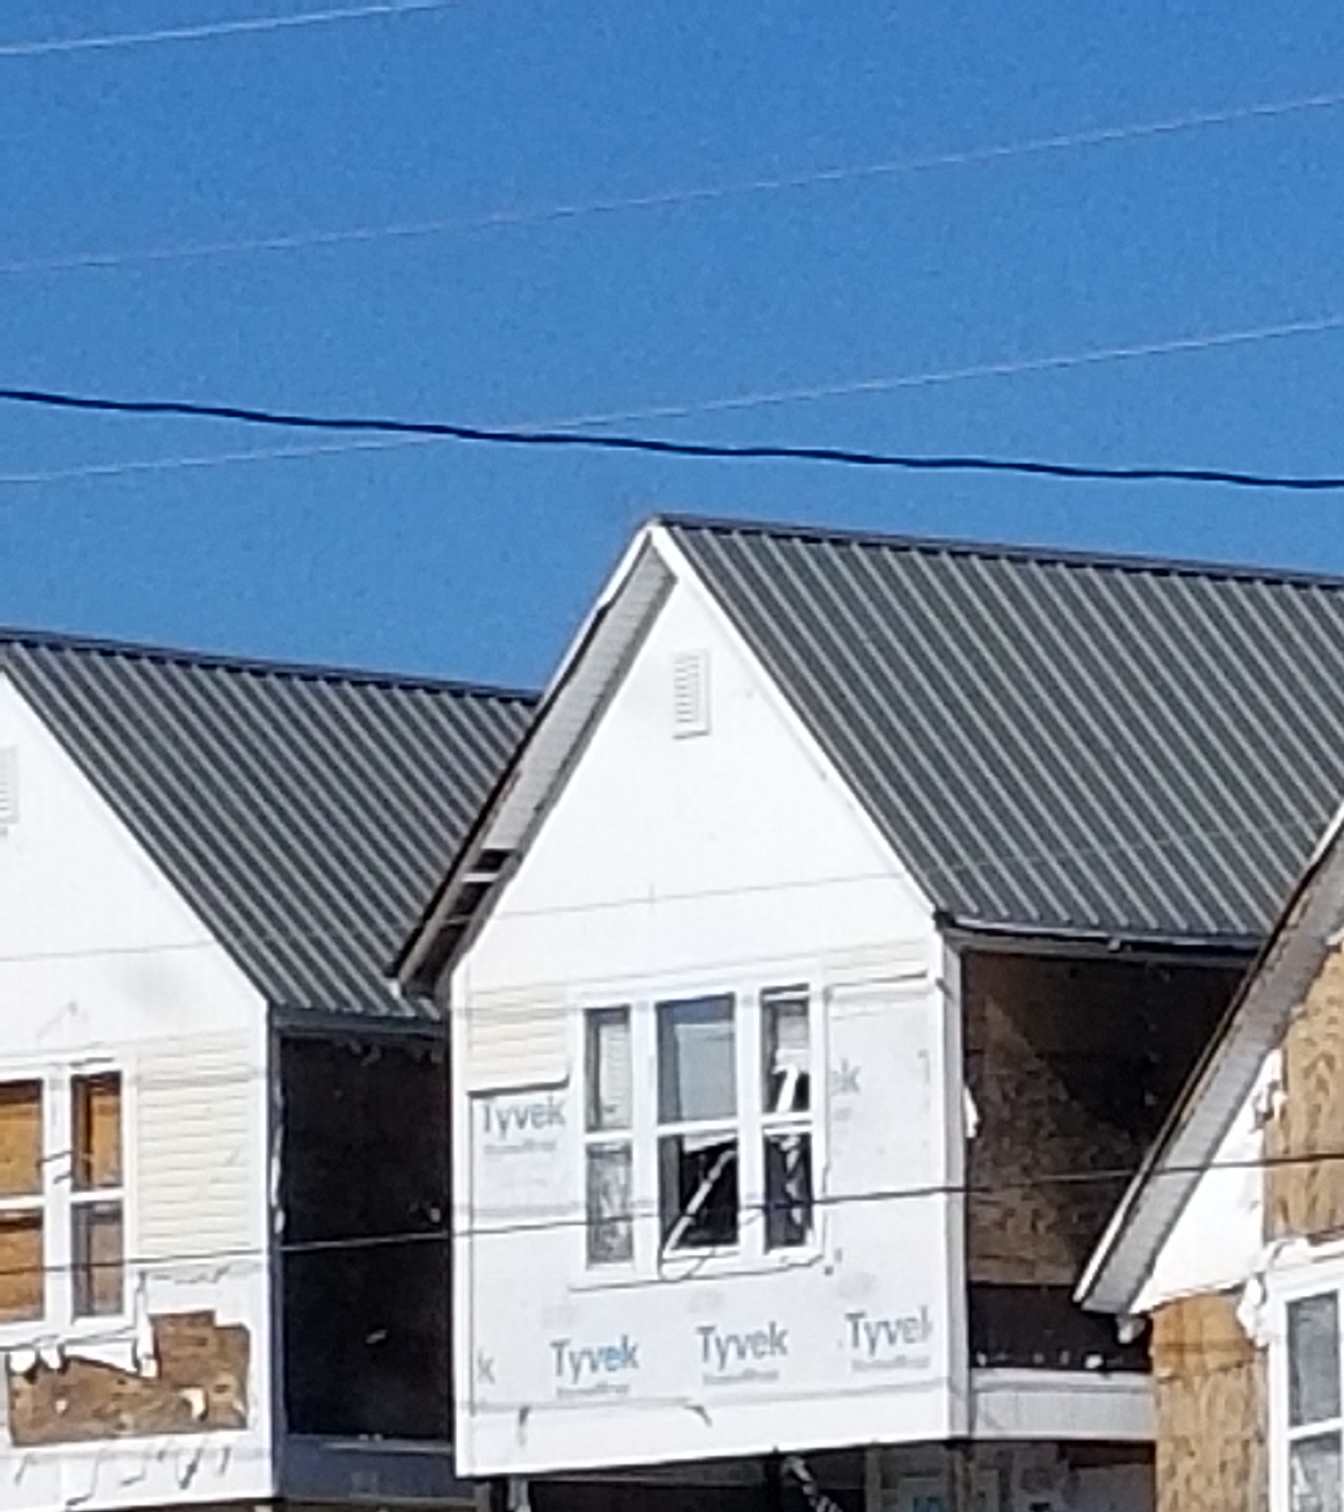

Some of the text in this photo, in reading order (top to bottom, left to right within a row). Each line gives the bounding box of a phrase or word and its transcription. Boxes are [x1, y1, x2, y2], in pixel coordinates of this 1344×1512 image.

[481, 1094, 567, 1140] Tyvek
[550, 1333, 640, 1385] Tyvek
[696, 1320, 788, 1371] Tyvek
